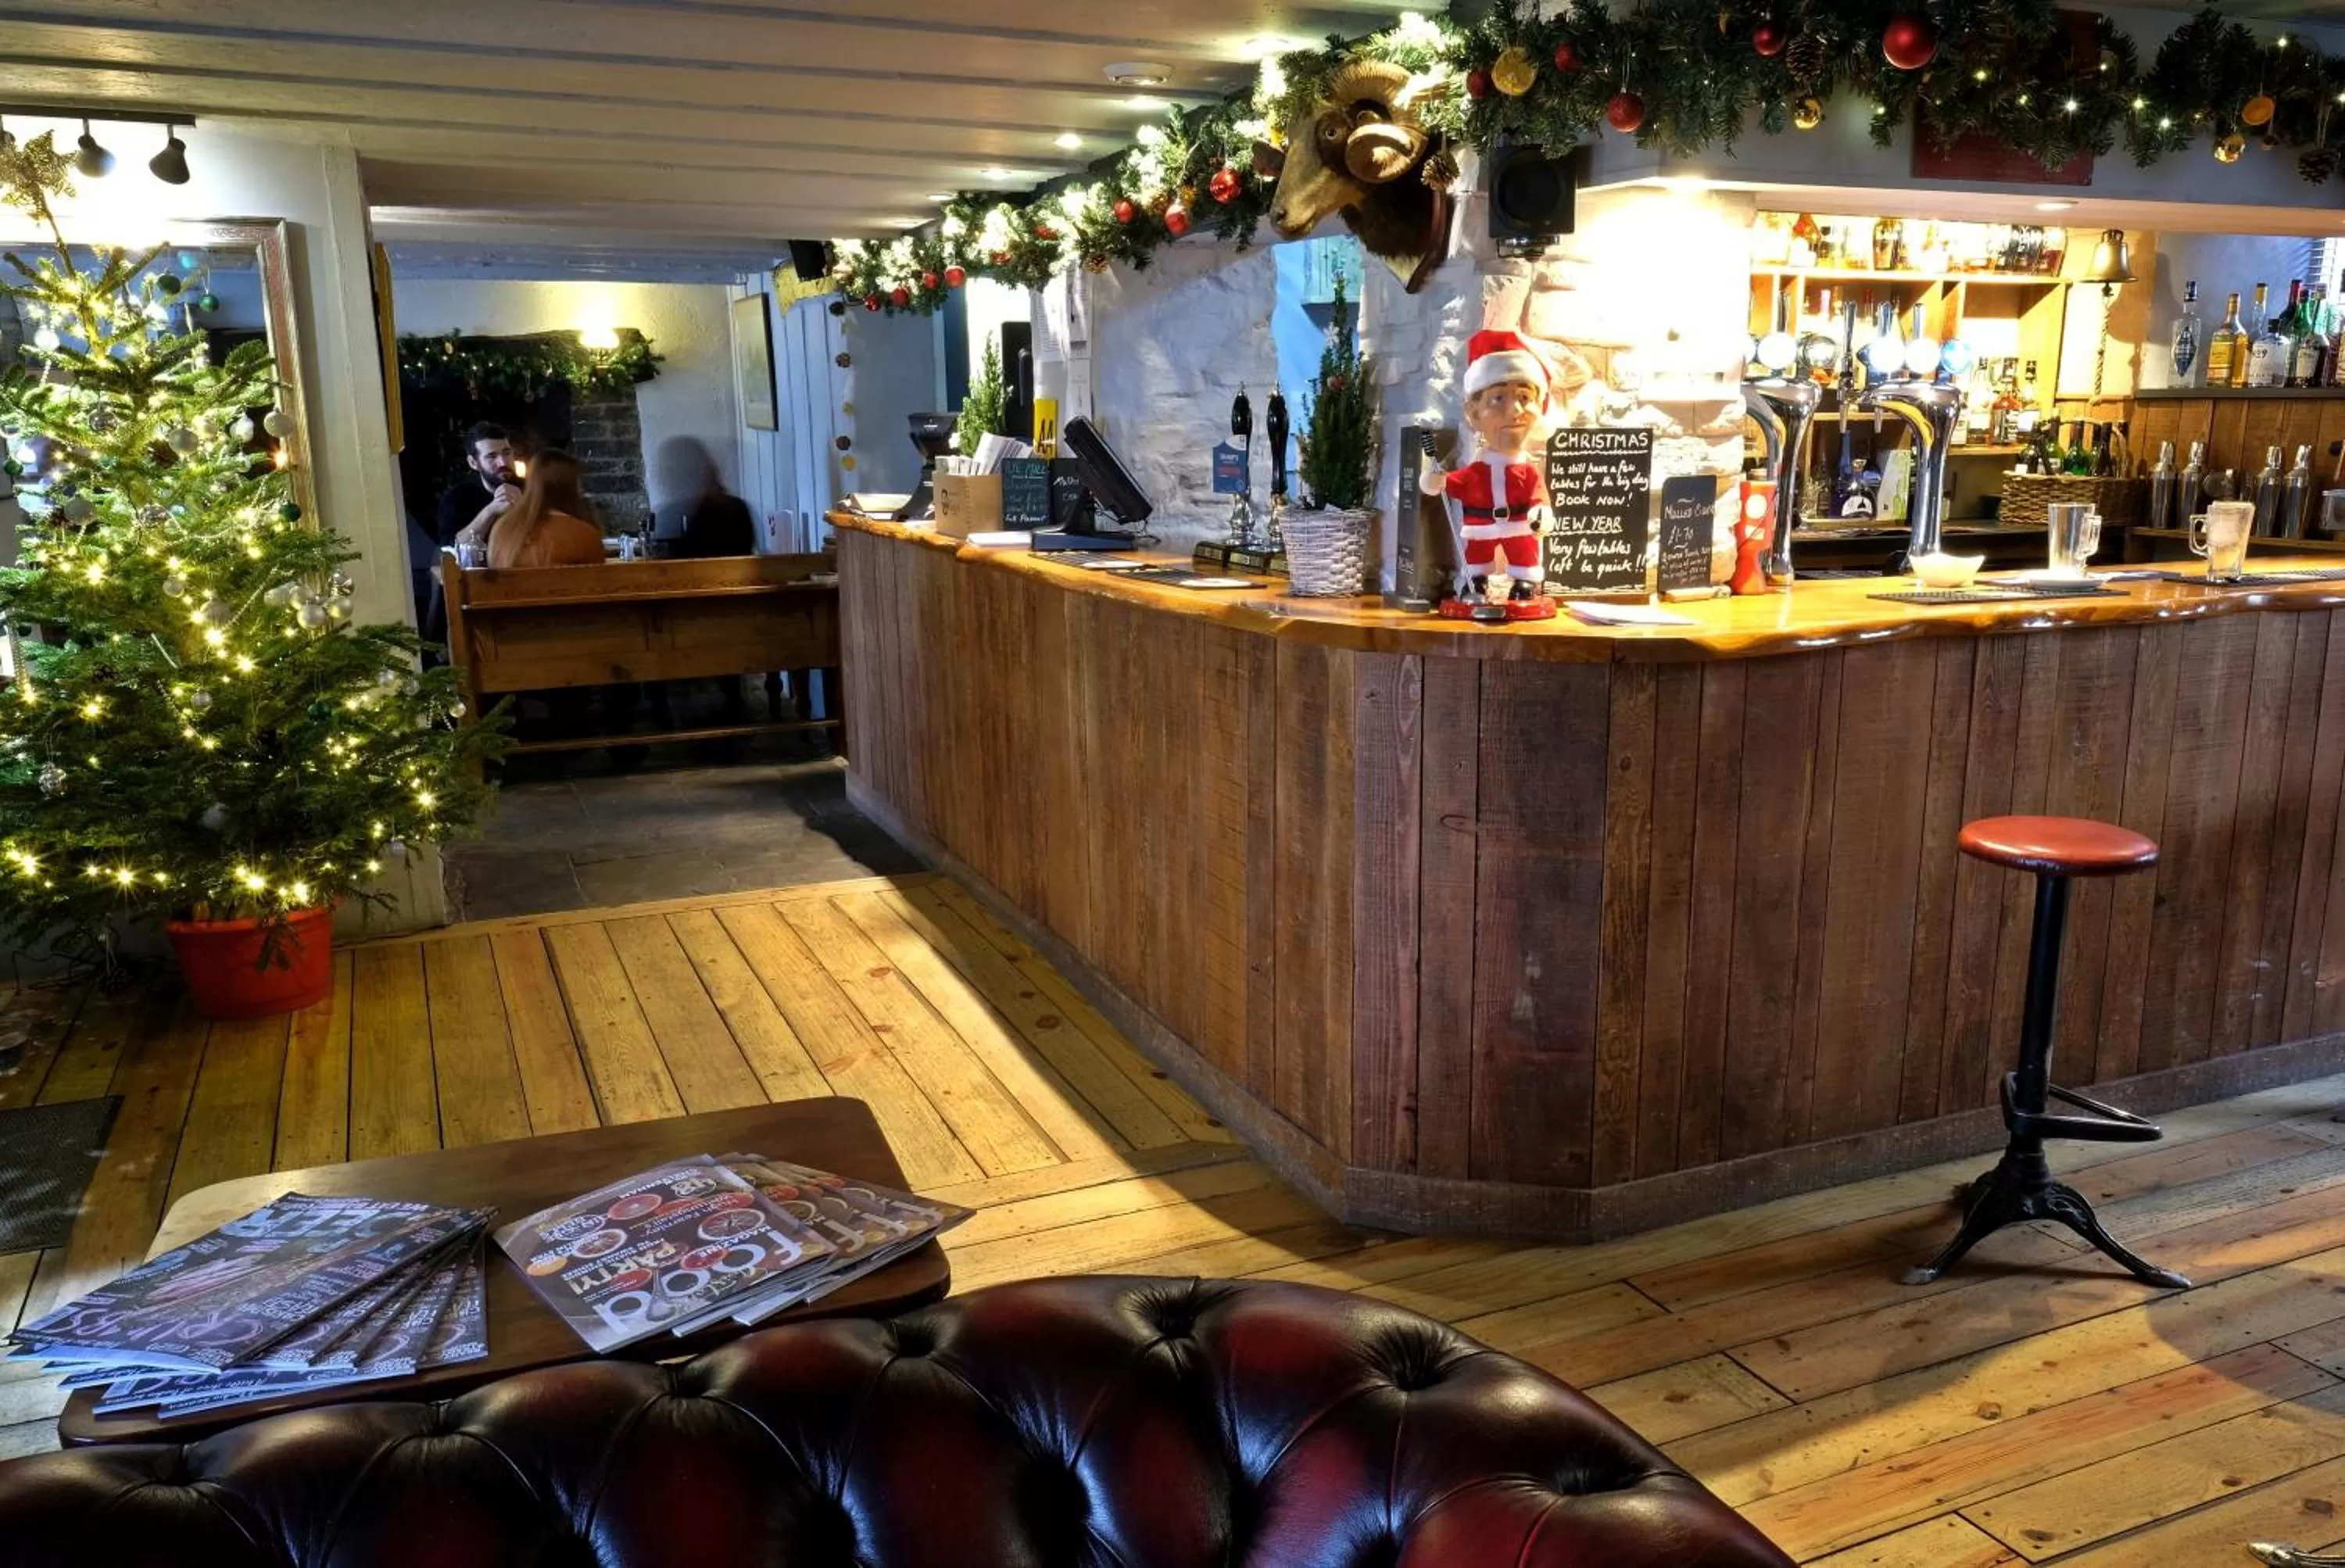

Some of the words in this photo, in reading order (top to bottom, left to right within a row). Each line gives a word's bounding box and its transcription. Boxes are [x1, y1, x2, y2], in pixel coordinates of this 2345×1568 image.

[1554, 432, 1649, 449] CHRISTMAS
[1552, 463, 1564, 474] We
[1568, 462, 1586, 474] still
[1588, 462, 1607, 474] have
[1617, 460, 1636, 478] few
[1551, 478, 1580, 490] tables
[1583, 474, 1596, 492] for
[1616, 475, 1630, 491] big
[1632, 471, 1649, 492] day
[1553, 516, 1587, 531] NEW
[1591, 516, 1622, 531] YEAR
[1549, 537, 1573, 560] Very
[1576, 538, 1597, 560] few
[1597, 539, 1631, 557] tables
[1549, 558, 1573, 575] left
[1581, 559, 1592, 573] be
[697, 1224, 772, 1257] MAGAZINE
[568, 1241, 677, 1296] PARTY!
[592, 1229, 804, 1334] food
